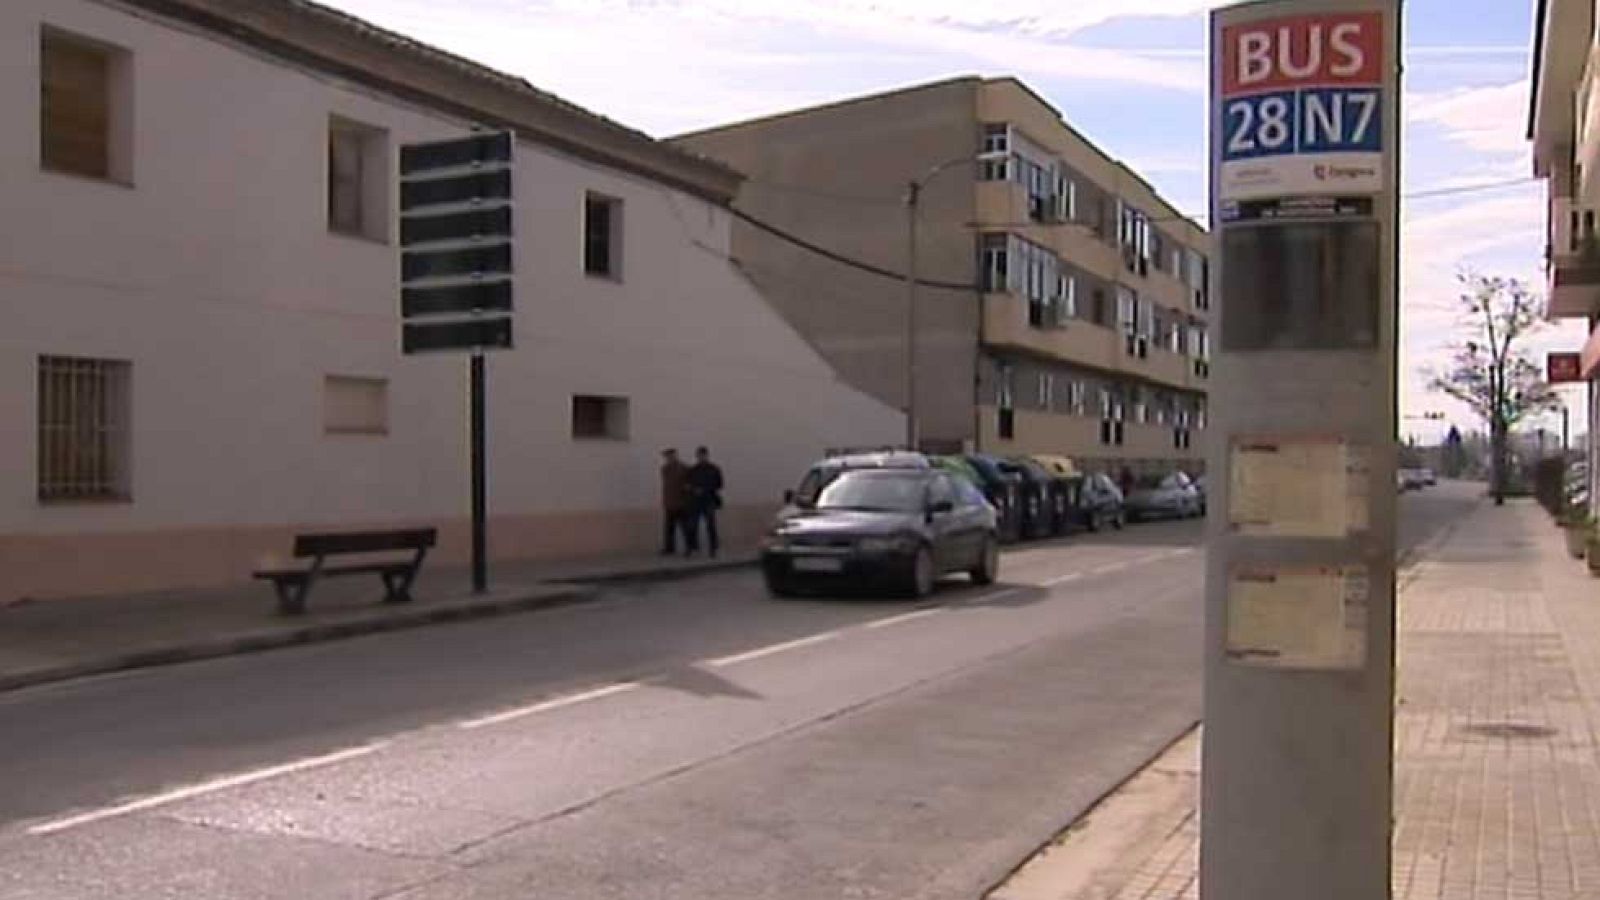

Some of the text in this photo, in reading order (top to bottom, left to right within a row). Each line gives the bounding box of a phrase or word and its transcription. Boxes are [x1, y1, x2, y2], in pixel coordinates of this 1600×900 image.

[1238, 23, 1364, 84] BUS
[1229, 92, 1377, 152] 28 N7
